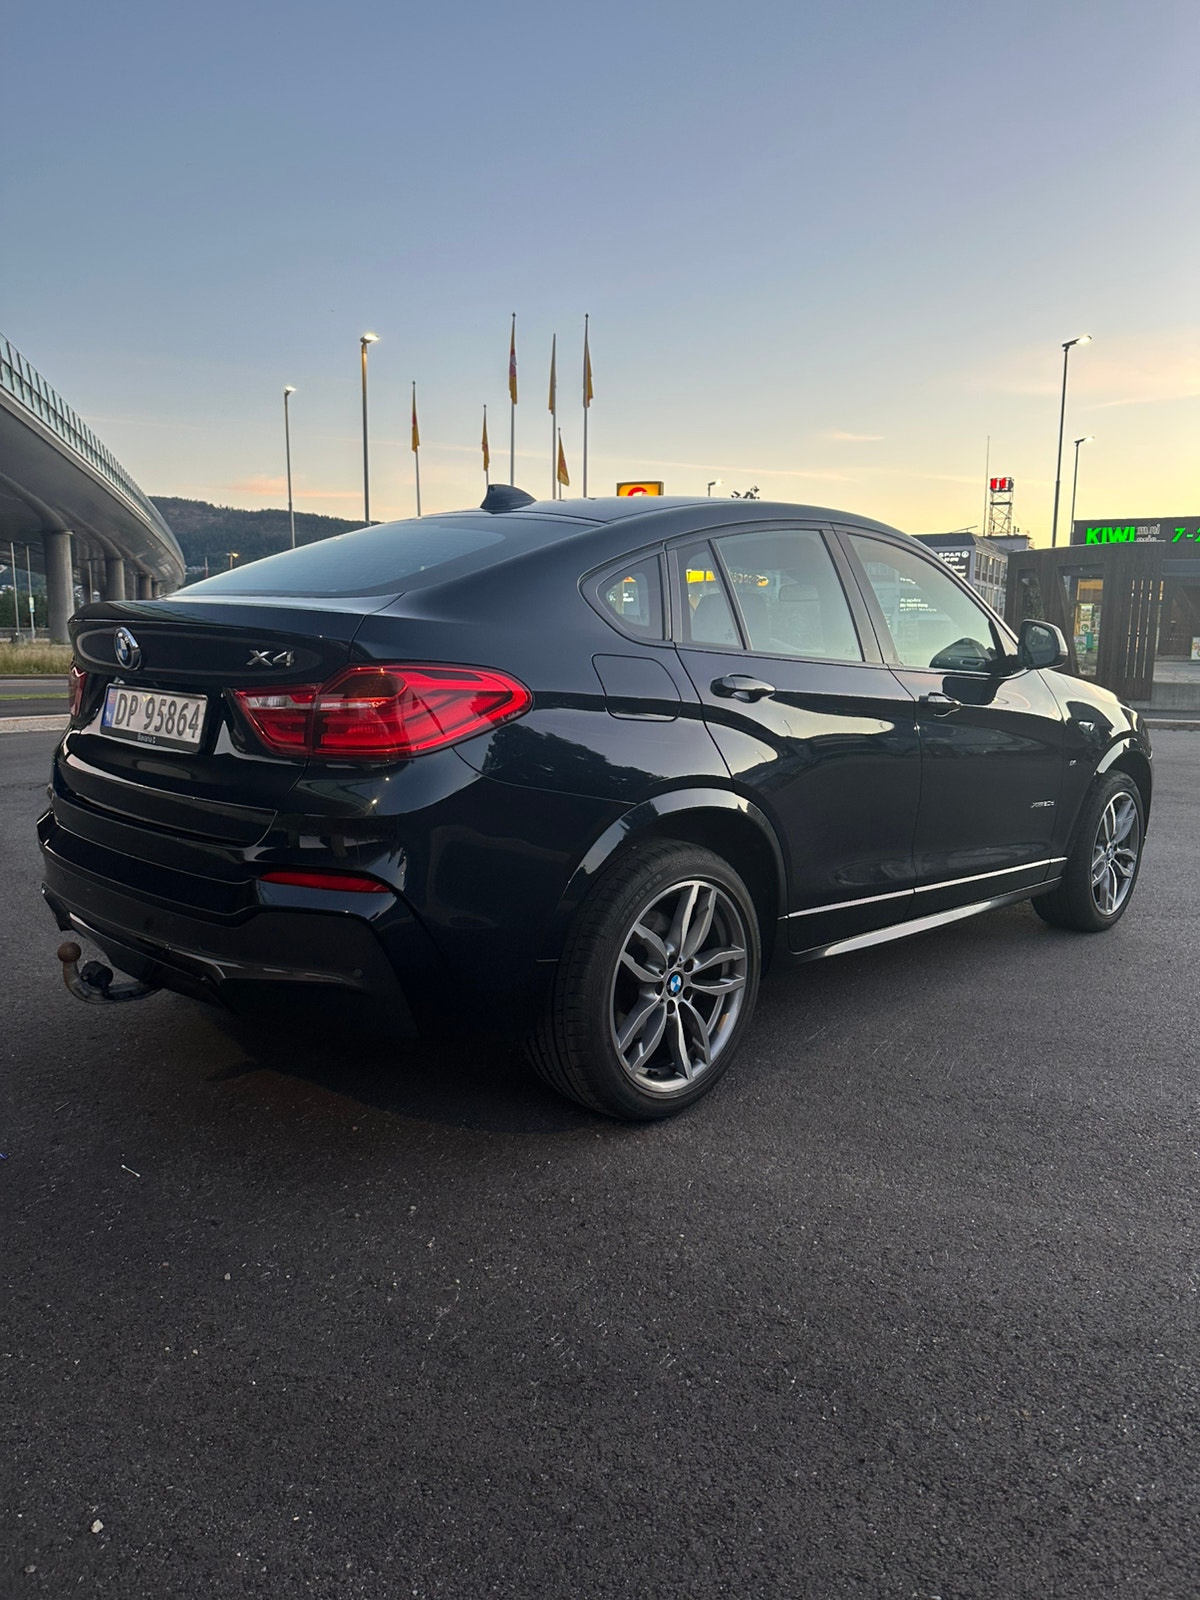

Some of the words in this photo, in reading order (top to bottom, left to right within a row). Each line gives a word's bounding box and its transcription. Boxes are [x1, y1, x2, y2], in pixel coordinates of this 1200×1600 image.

[1085, 526, 1136, 545] KIWI
[246, 649, 292, 667] X4
[114, 693, 139, 727] DP
[143, 697, 201, 739] 95864
